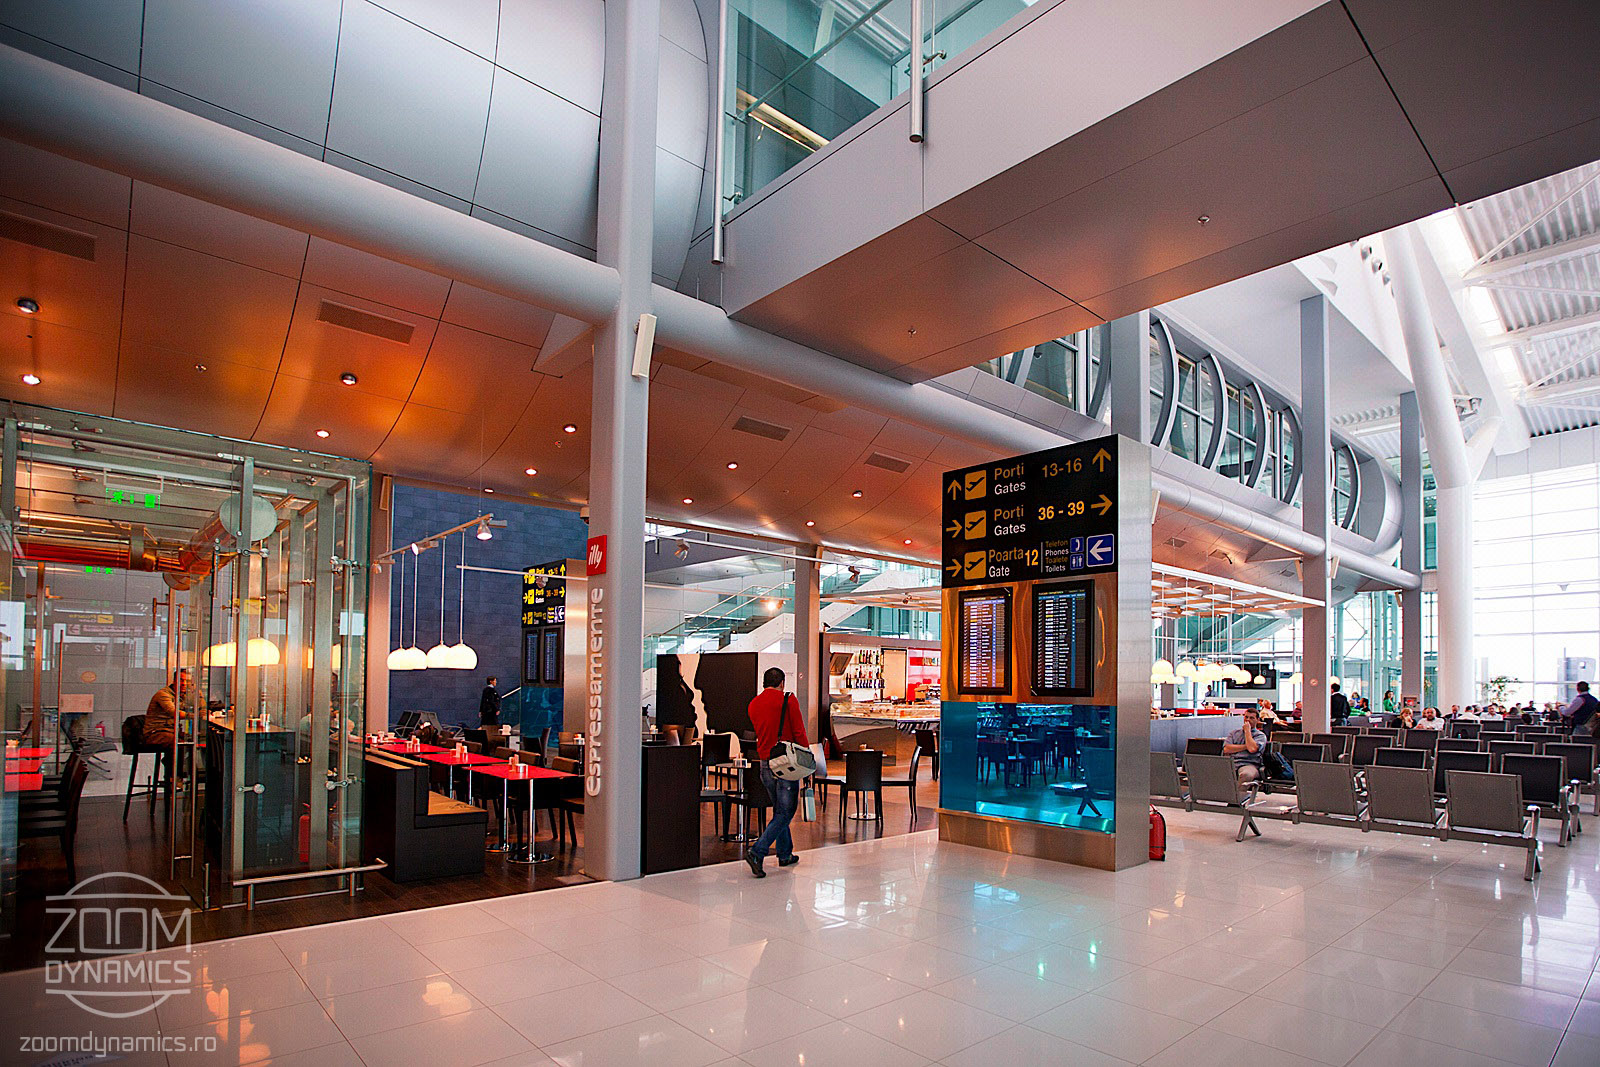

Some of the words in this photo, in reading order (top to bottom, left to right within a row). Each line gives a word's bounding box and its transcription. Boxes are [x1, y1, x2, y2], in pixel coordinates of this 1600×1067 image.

[1042, 457, 1083, 478] 13-16
[994, 481, 1026, 495] Gates
[1037, 505, 1054, 521] 36
[1067, 501, 1085, 516] 39
[994, 523, 1026, 536] Gates
[1045, 540, 1069, 548] Telefon
[588, 544, 603, 569] illy
[988, 547, 1024, 563] Poarta
[1025, 549, 1039, 566] 12
[1045, 548, 1069, 556] Phones
[1045, 556, 1069, 564] Toalete
[988, 565, 1010, 578] Gate
[1045, 564, 1066, 573] Toilets
